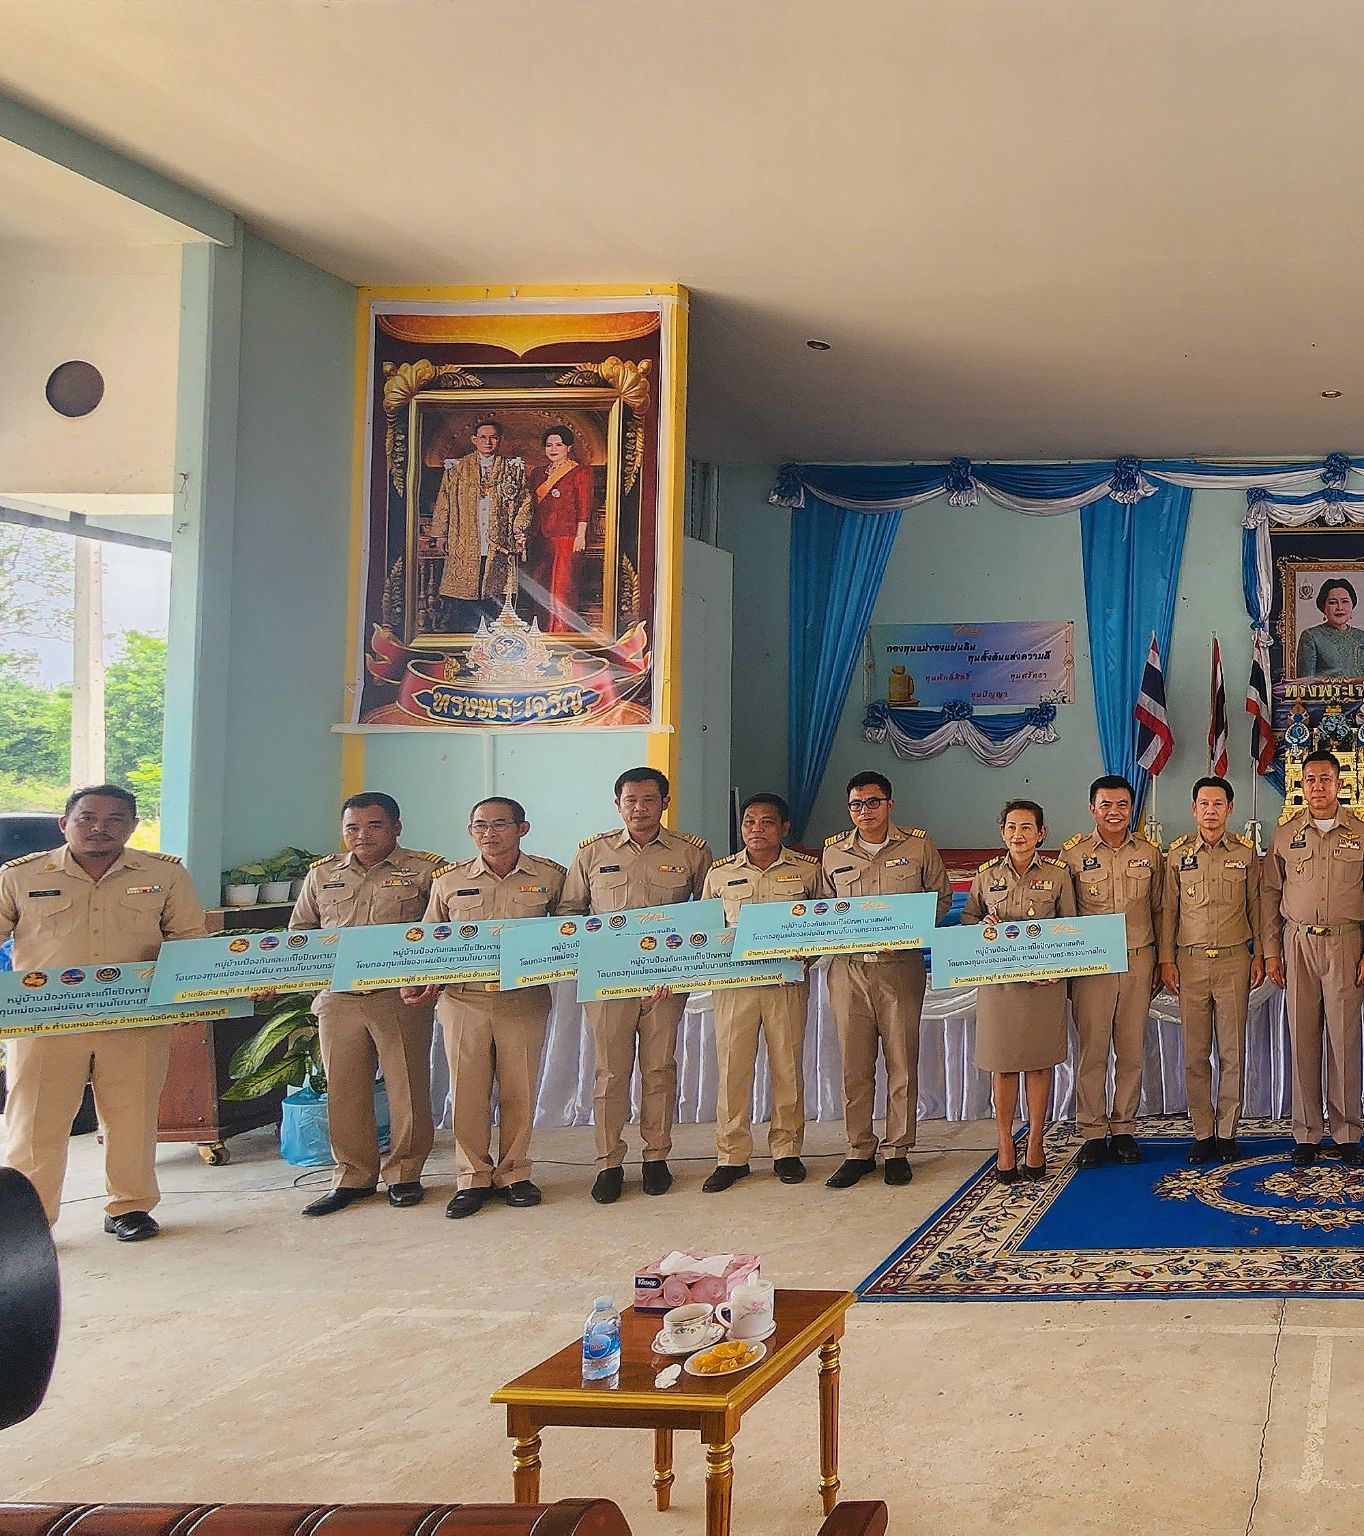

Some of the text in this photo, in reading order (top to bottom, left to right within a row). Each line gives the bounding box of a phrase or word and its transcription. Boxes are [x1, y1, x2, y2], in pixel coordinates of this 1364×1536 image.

[886, 641, 977, 655] กองทุนแม่ของแผ่นดิน
[967, 650, 1052, 665] ทุนตั้งต้นแห่งความดี
[1010, 671, 1048, 682] ทุนศรัทธา
[970, 690, 1009, 702] ทุนปัญญา
[432, 688, 585, 719] ทรงพระเจริญ
[630, 951, 733, 967] หมู่บ้านป้องกันและแก้ไขปัญหาย
